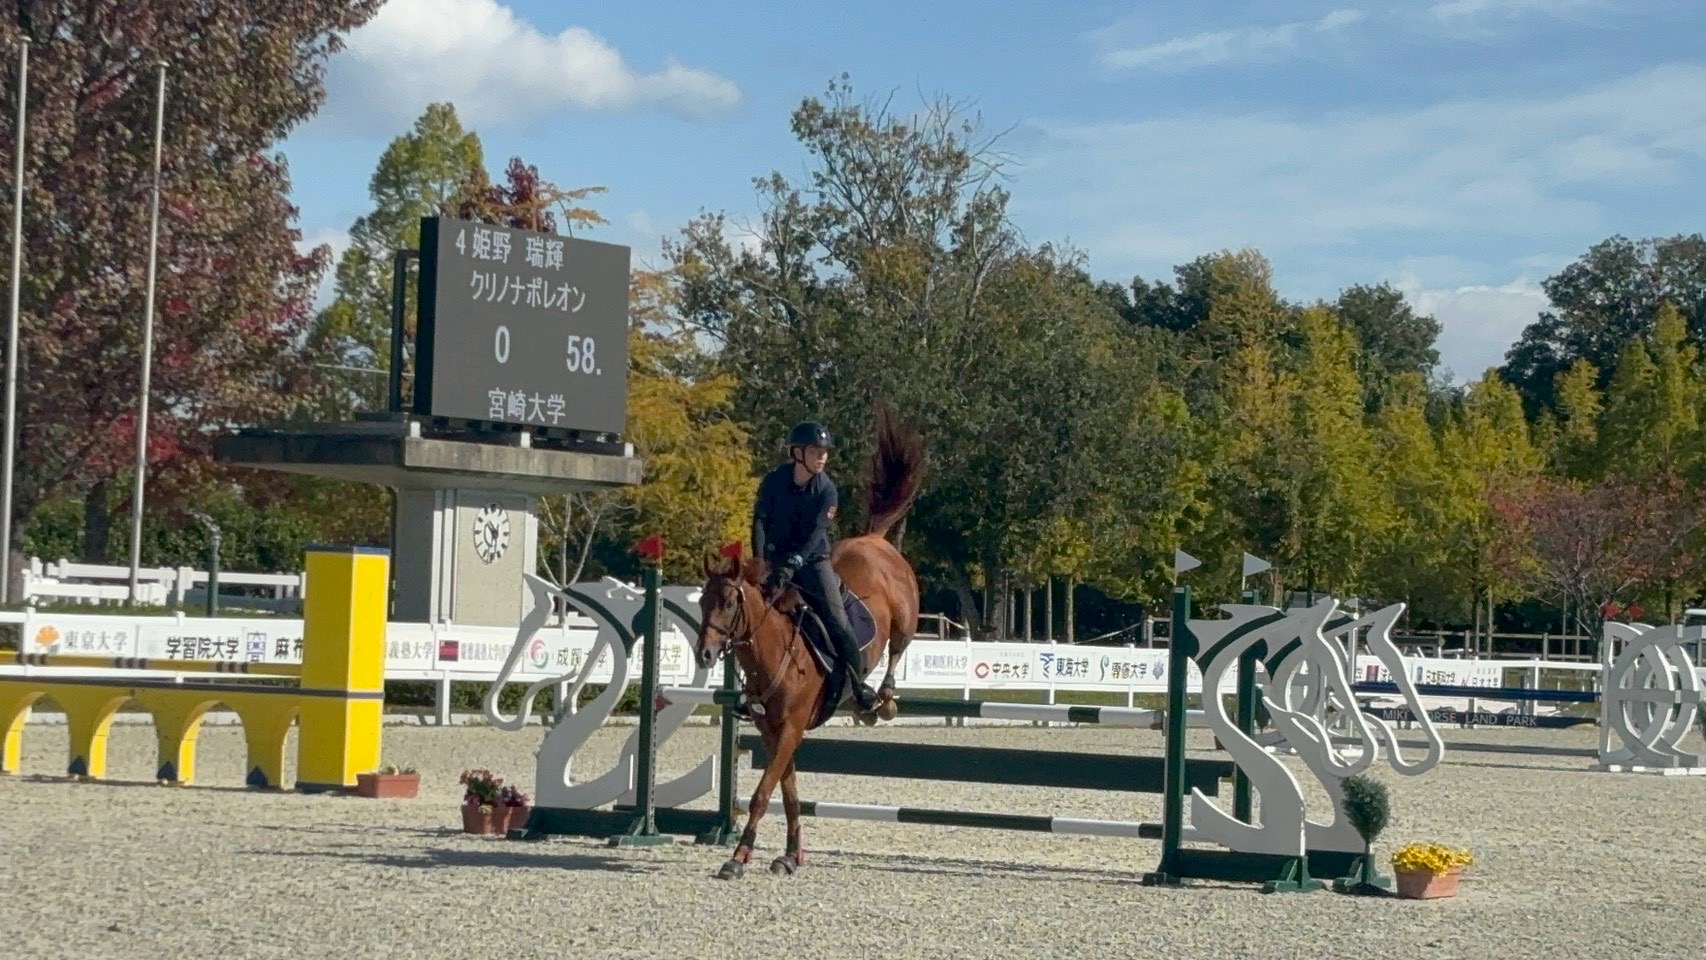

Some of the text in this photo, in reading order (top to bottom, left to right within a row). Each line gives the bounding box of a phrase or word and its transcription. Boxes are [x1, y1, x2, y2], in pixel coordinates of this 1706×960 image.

[455, 228, 466, 255] 4
[470, 270, 586, 313] クリノナポレオン
[494, 325, 602, 376] 0 58.
[488, 387, 566, 425] 宮崎大学
[64, 631, 128, 651] 東京大学
[166, 636, 239, 659] 学習院大学
[1056, 657, 1089, 677] 東海大学
[1382, 709, 1408, 720] MIKI
[1465, 713, 1498, 725] LAND
[1506, 714, 1538, 727] PARK
